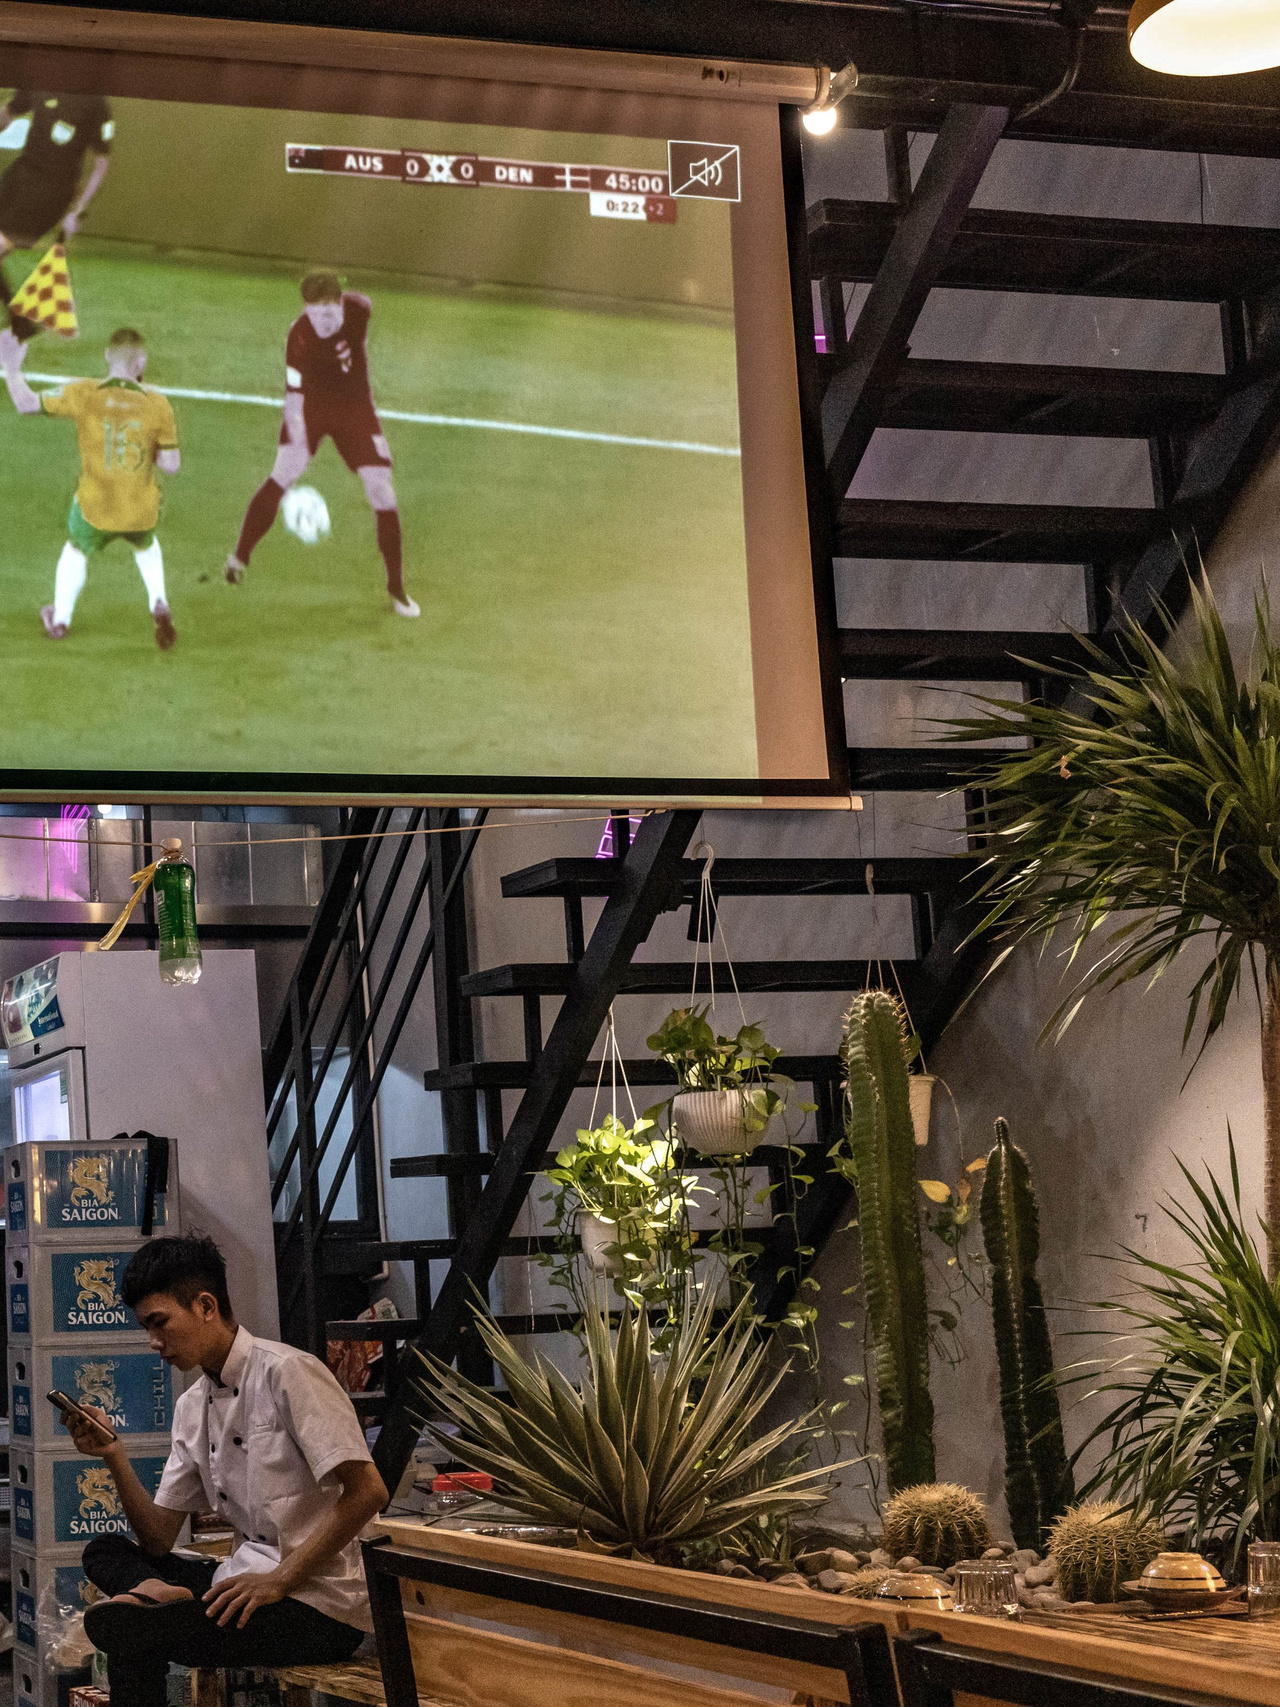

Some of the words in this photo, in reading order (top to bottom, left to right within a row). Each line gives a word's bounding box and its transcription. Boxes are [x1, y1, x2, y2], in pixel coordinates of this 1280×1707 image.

[344, 154, 384, 172] AUS
[406, 159, 419, 176] 0
[460, 162, 473, 179] 0
[494, 165, 534, 183] DEN
[605, 173, 664, 193] 45:00
[606, 200, 639, 214] 0:22
[81, 1199, 99, 1208] BIA
[61, 1208, 118, 1221] SAIGON
[88, 1302, 106, 1311] BIA
[68, 1311, 125, 1325] SAIGON
[152, 1359, 165, 1426] CHILL
[90, 1511, 108, 1520] BIA
[70, 1519, 128, 1534] SAIGON
